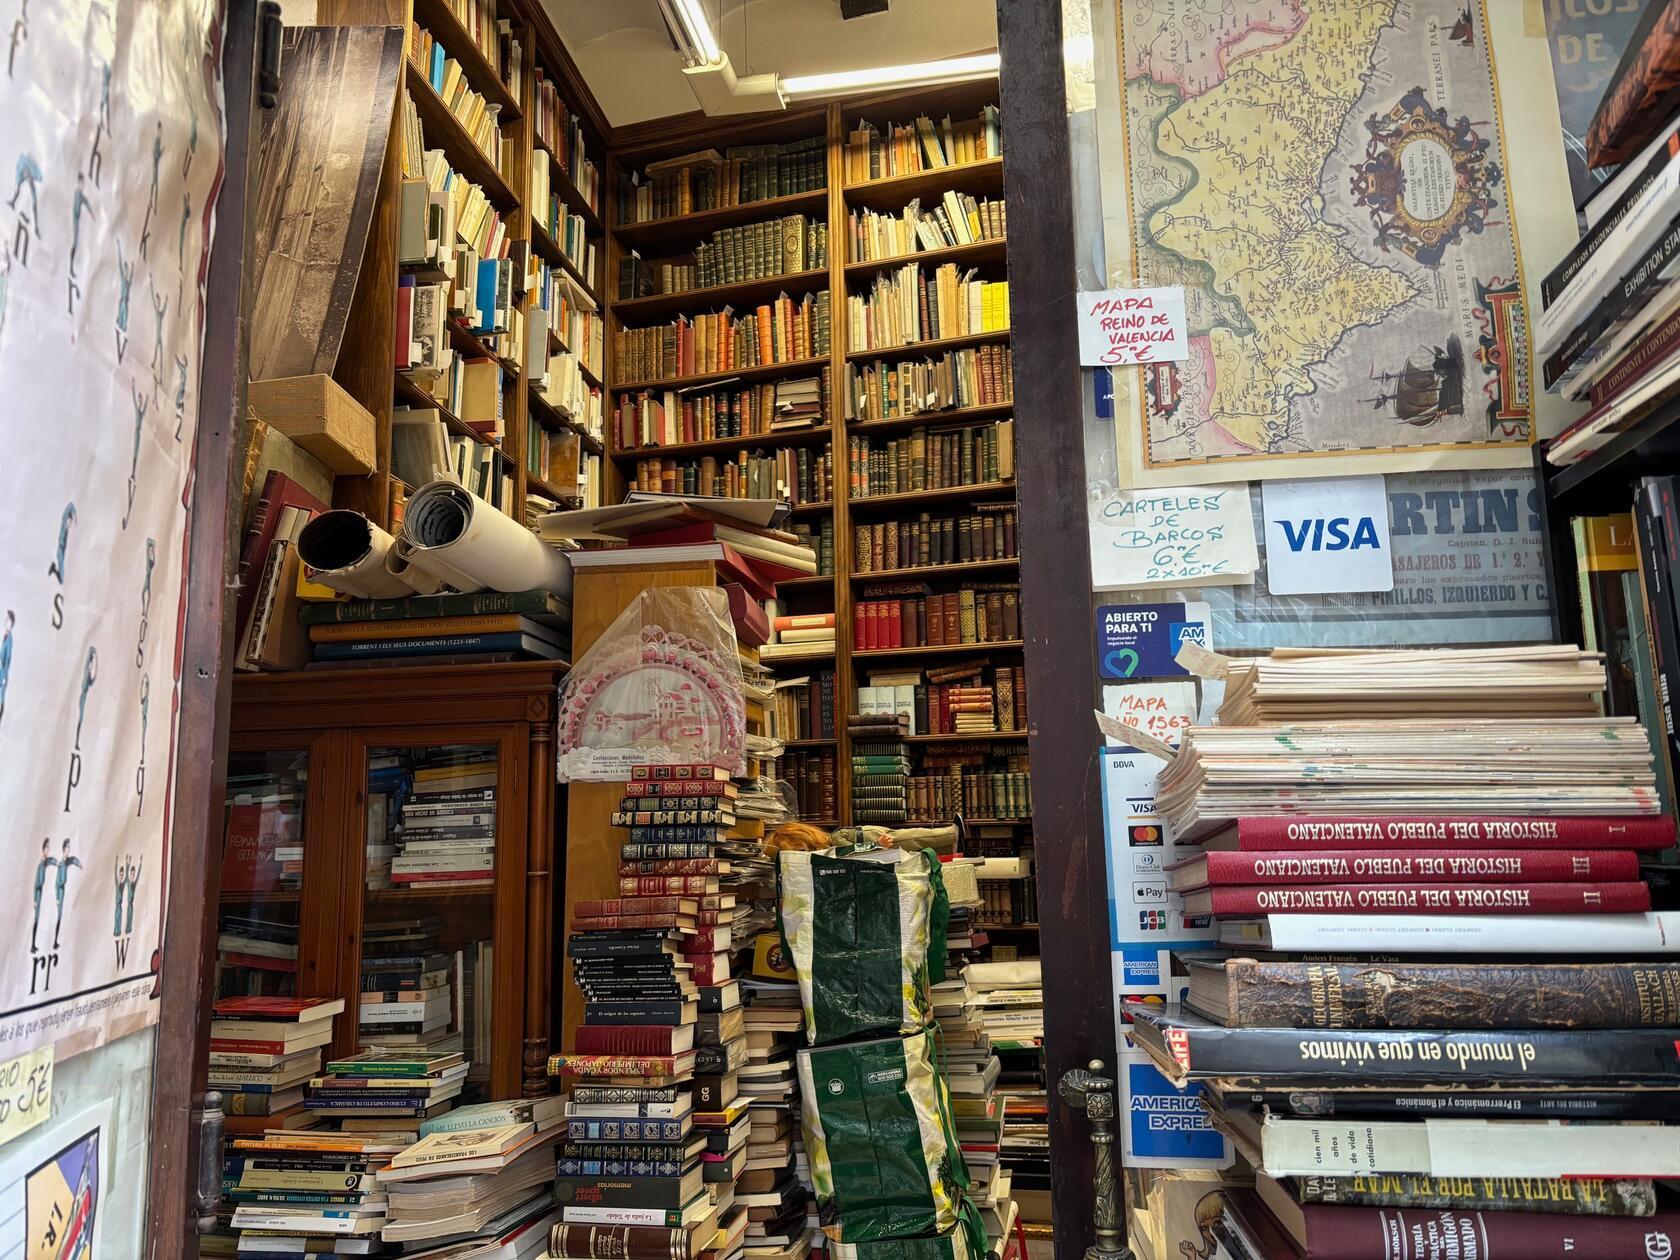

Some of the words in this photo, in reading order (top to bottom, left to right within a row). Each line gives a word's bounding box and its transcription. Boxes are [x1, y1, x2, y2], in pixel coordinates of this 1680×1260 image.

[1557, 32, 1608, 65] DE
[1623, 250, 1664, 300] EXHIBITION
[1090, 296, 1154, 317] MAPA
[1100, 316, 1145, 332] REINO
[1150, 313, 1170, 326] DE
[1108, 327, 1175, 346] VALENCIA
[1103, 491, 1226, 518] CARTELES
[1389, 488, 1519, 536] RTIN
[1149, 514, 1180, 528] DE
[1113, 525, 1225, 549] BARCOS
[1272, 516, 1381, 552] VISA
[1390, 554, 1457, 572] ASAJEROS
[1463, 553, 1481, 570] DE
[1441, 584, 1516, 604] IZQUIERDO
[1105, 611, 1158, 623] ABIERTO
[1105, 624, 1139, 634] PARA
[1140, 623, 1152, 633] TI
[1181, 628, 1205, 639] AM
[407, 640, 447, 648] DOCUMENTS
[1119, 694, 1168, 711] MAPA
[1115, 712, 1139, 728] ÑO
[1147, 715, 1191, 730] 1563
[1113, 760, 1135, 768] BBVA
[1131, 803, 1157, 813] VISA
[1287, 822, 1385, 840] VALENCIANO
[1387, 822, 1447, 839] PUEBLO
[1453, 821, 1480, 839] DEL
[1481, 821, 1559, 839] HISTORIA
[1254, 859, 1351, 876] VALENCIANO
[1353, 858, 1412, 875] PUEBLO
[1415, 857, 1444, 875] DEL
[1449, 857, 1522, 875] HISTORIA
[1145, 887, 1163, 898] Pay
[1256, 889, 1353, 908] VALENCIANO
[1357, 889, 1418, 908] PUEBLO
[1420, 889, 1452, 907] DEL
[1454, 888, 1530, 907] HISTORIA
[1300, 1041, 1374, 1066] vivimos
[1378, 1041, 1413, 1059] que
[1419, 1041, 1441, 1059] en
[1445, 1041, 1511, 1070] mundo
[1518, 1040, 1536, 1071] el
[1131, 1095, 1203, 1111] AMERICA
[1395, 1097, 1437, 1108] Románico
[1437, 1099, 1445, 1107] el
[1454, 1098, 1514, 1110] Prerrománico
[1514, 1100, 1522, 1110] El
[1149, 1114, 1213, 1130] EXPRE
[1331, 1136, 1339, 1157] años
[1367, 1127, 1376, 1168] cotidiana
[1350, 1151, 1357, 1164] de
[597, 1182, 632, 1190] memorias
[1352, 1175, 1402, 1194] MAR
[1413, 1176, 1431, 1195] EL
[1439, 1176, 1472, 1197] POR
[1482, 1177, 1575, 1200] BATALLA
[1583, 1178, 1608, 1201] LA
[1412, 1223, 1424, 1259] TEORÍA
